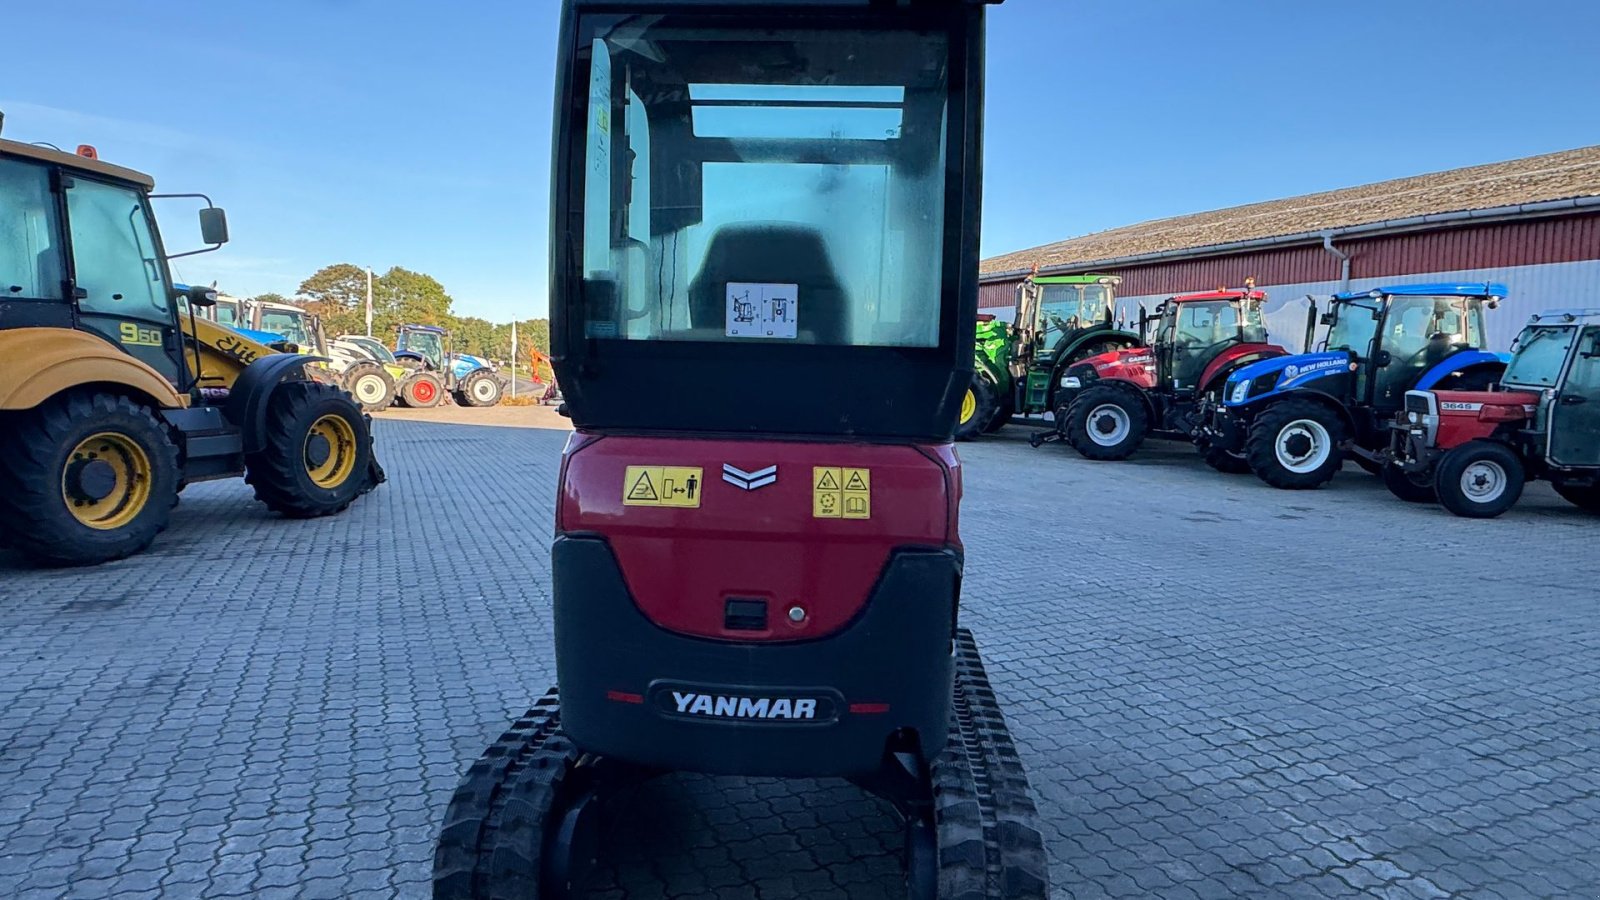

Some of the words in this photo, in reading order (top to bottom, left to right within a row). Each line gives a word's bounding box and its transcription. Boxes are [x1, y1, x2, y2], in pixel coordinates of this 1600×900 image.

[120, 322, 162, 343] 960
[1300, 363, 1316, 373] NEW
[1317, 359, 1348, 369] HOLLAND
[672, 691, 817, 719] YANMAR
